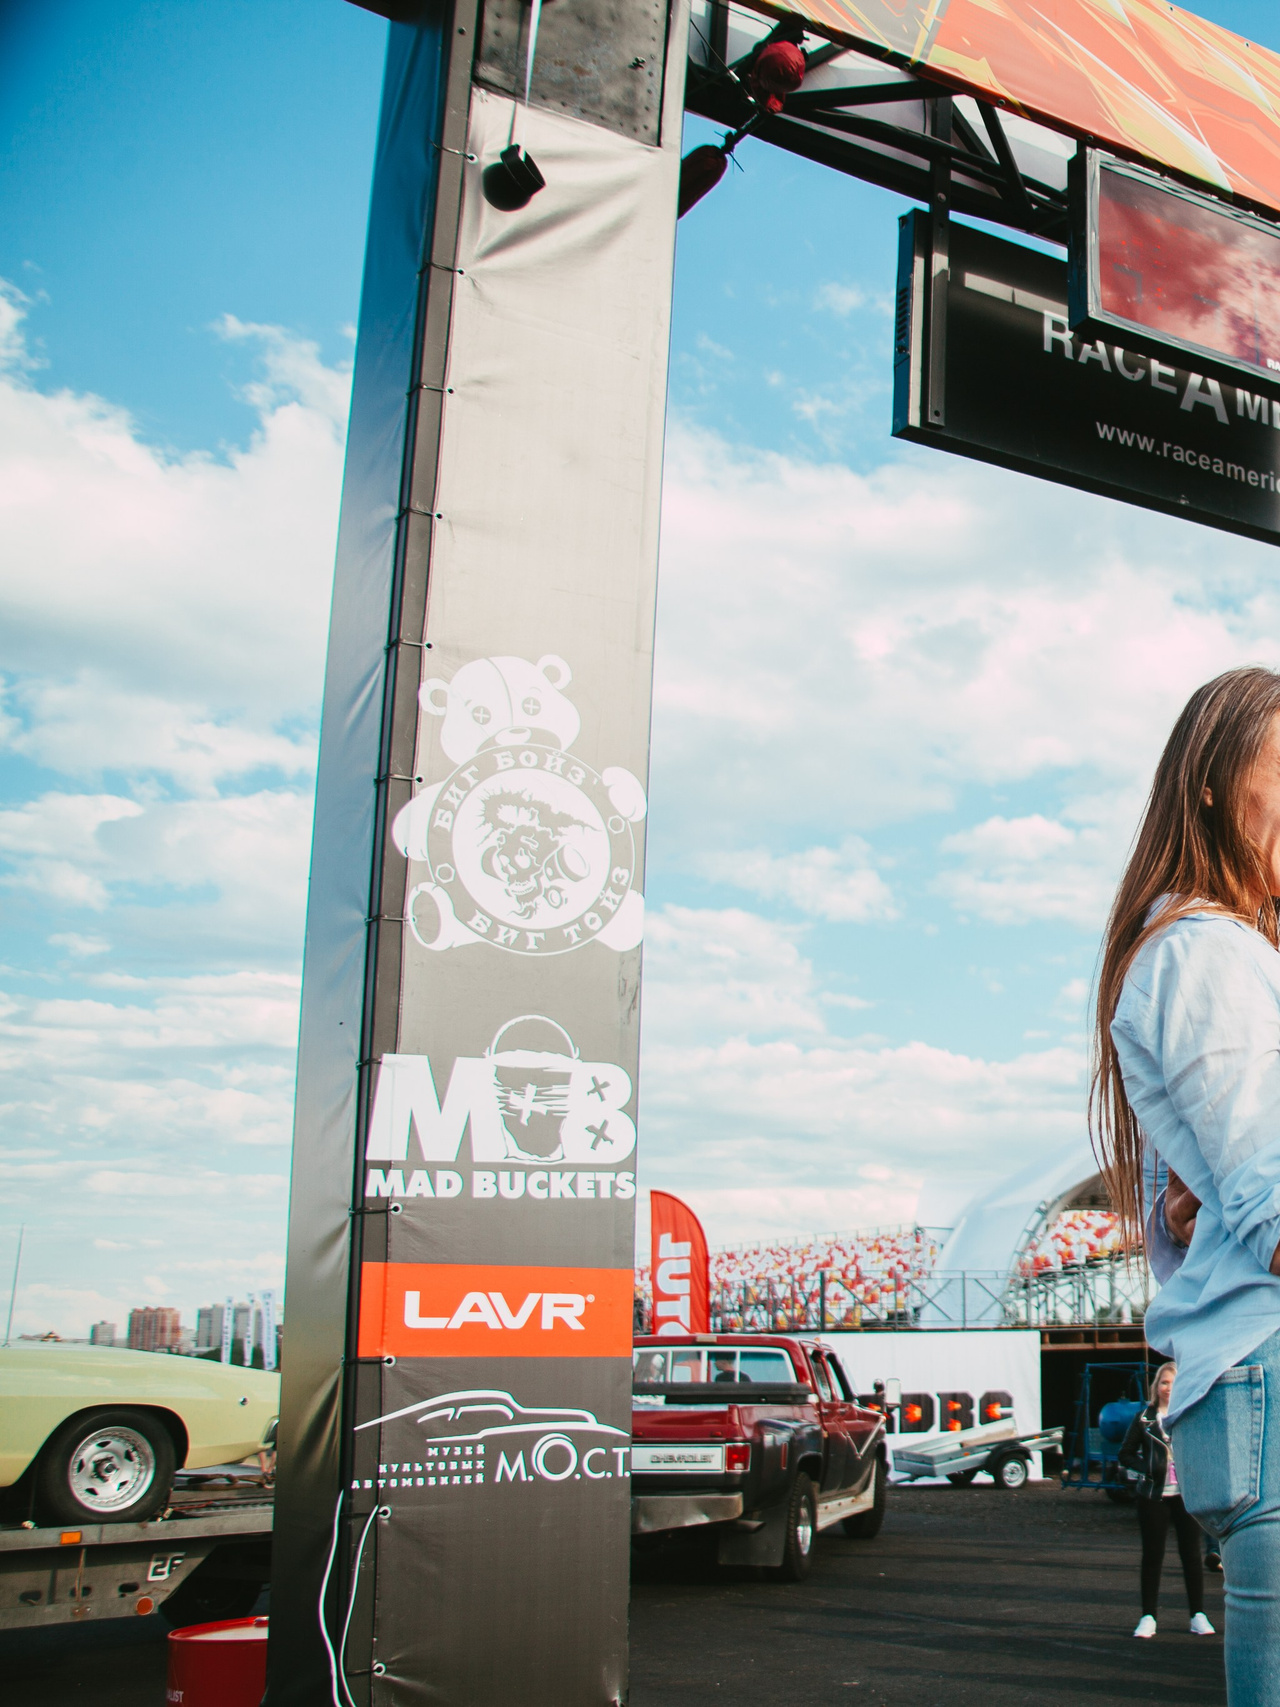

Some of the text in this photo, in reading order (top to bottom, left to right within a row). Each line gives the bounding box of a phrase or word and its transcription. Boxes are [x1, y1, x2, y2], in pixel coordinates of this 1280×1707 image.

[433, 766, 480, 832] БИГ
[466, 865, 631, 951] БИГ ТОЙЗ
[365, 1168, 637, 1200] MAD BUCKETS
[427, 1443, 486, 1457] МУЗЕЙ
[378, 1460, 486, 1473] КУЛЬТОВЫХ
[350, 1473, 486, 1489] АВТОМОБИЛЕЙ
